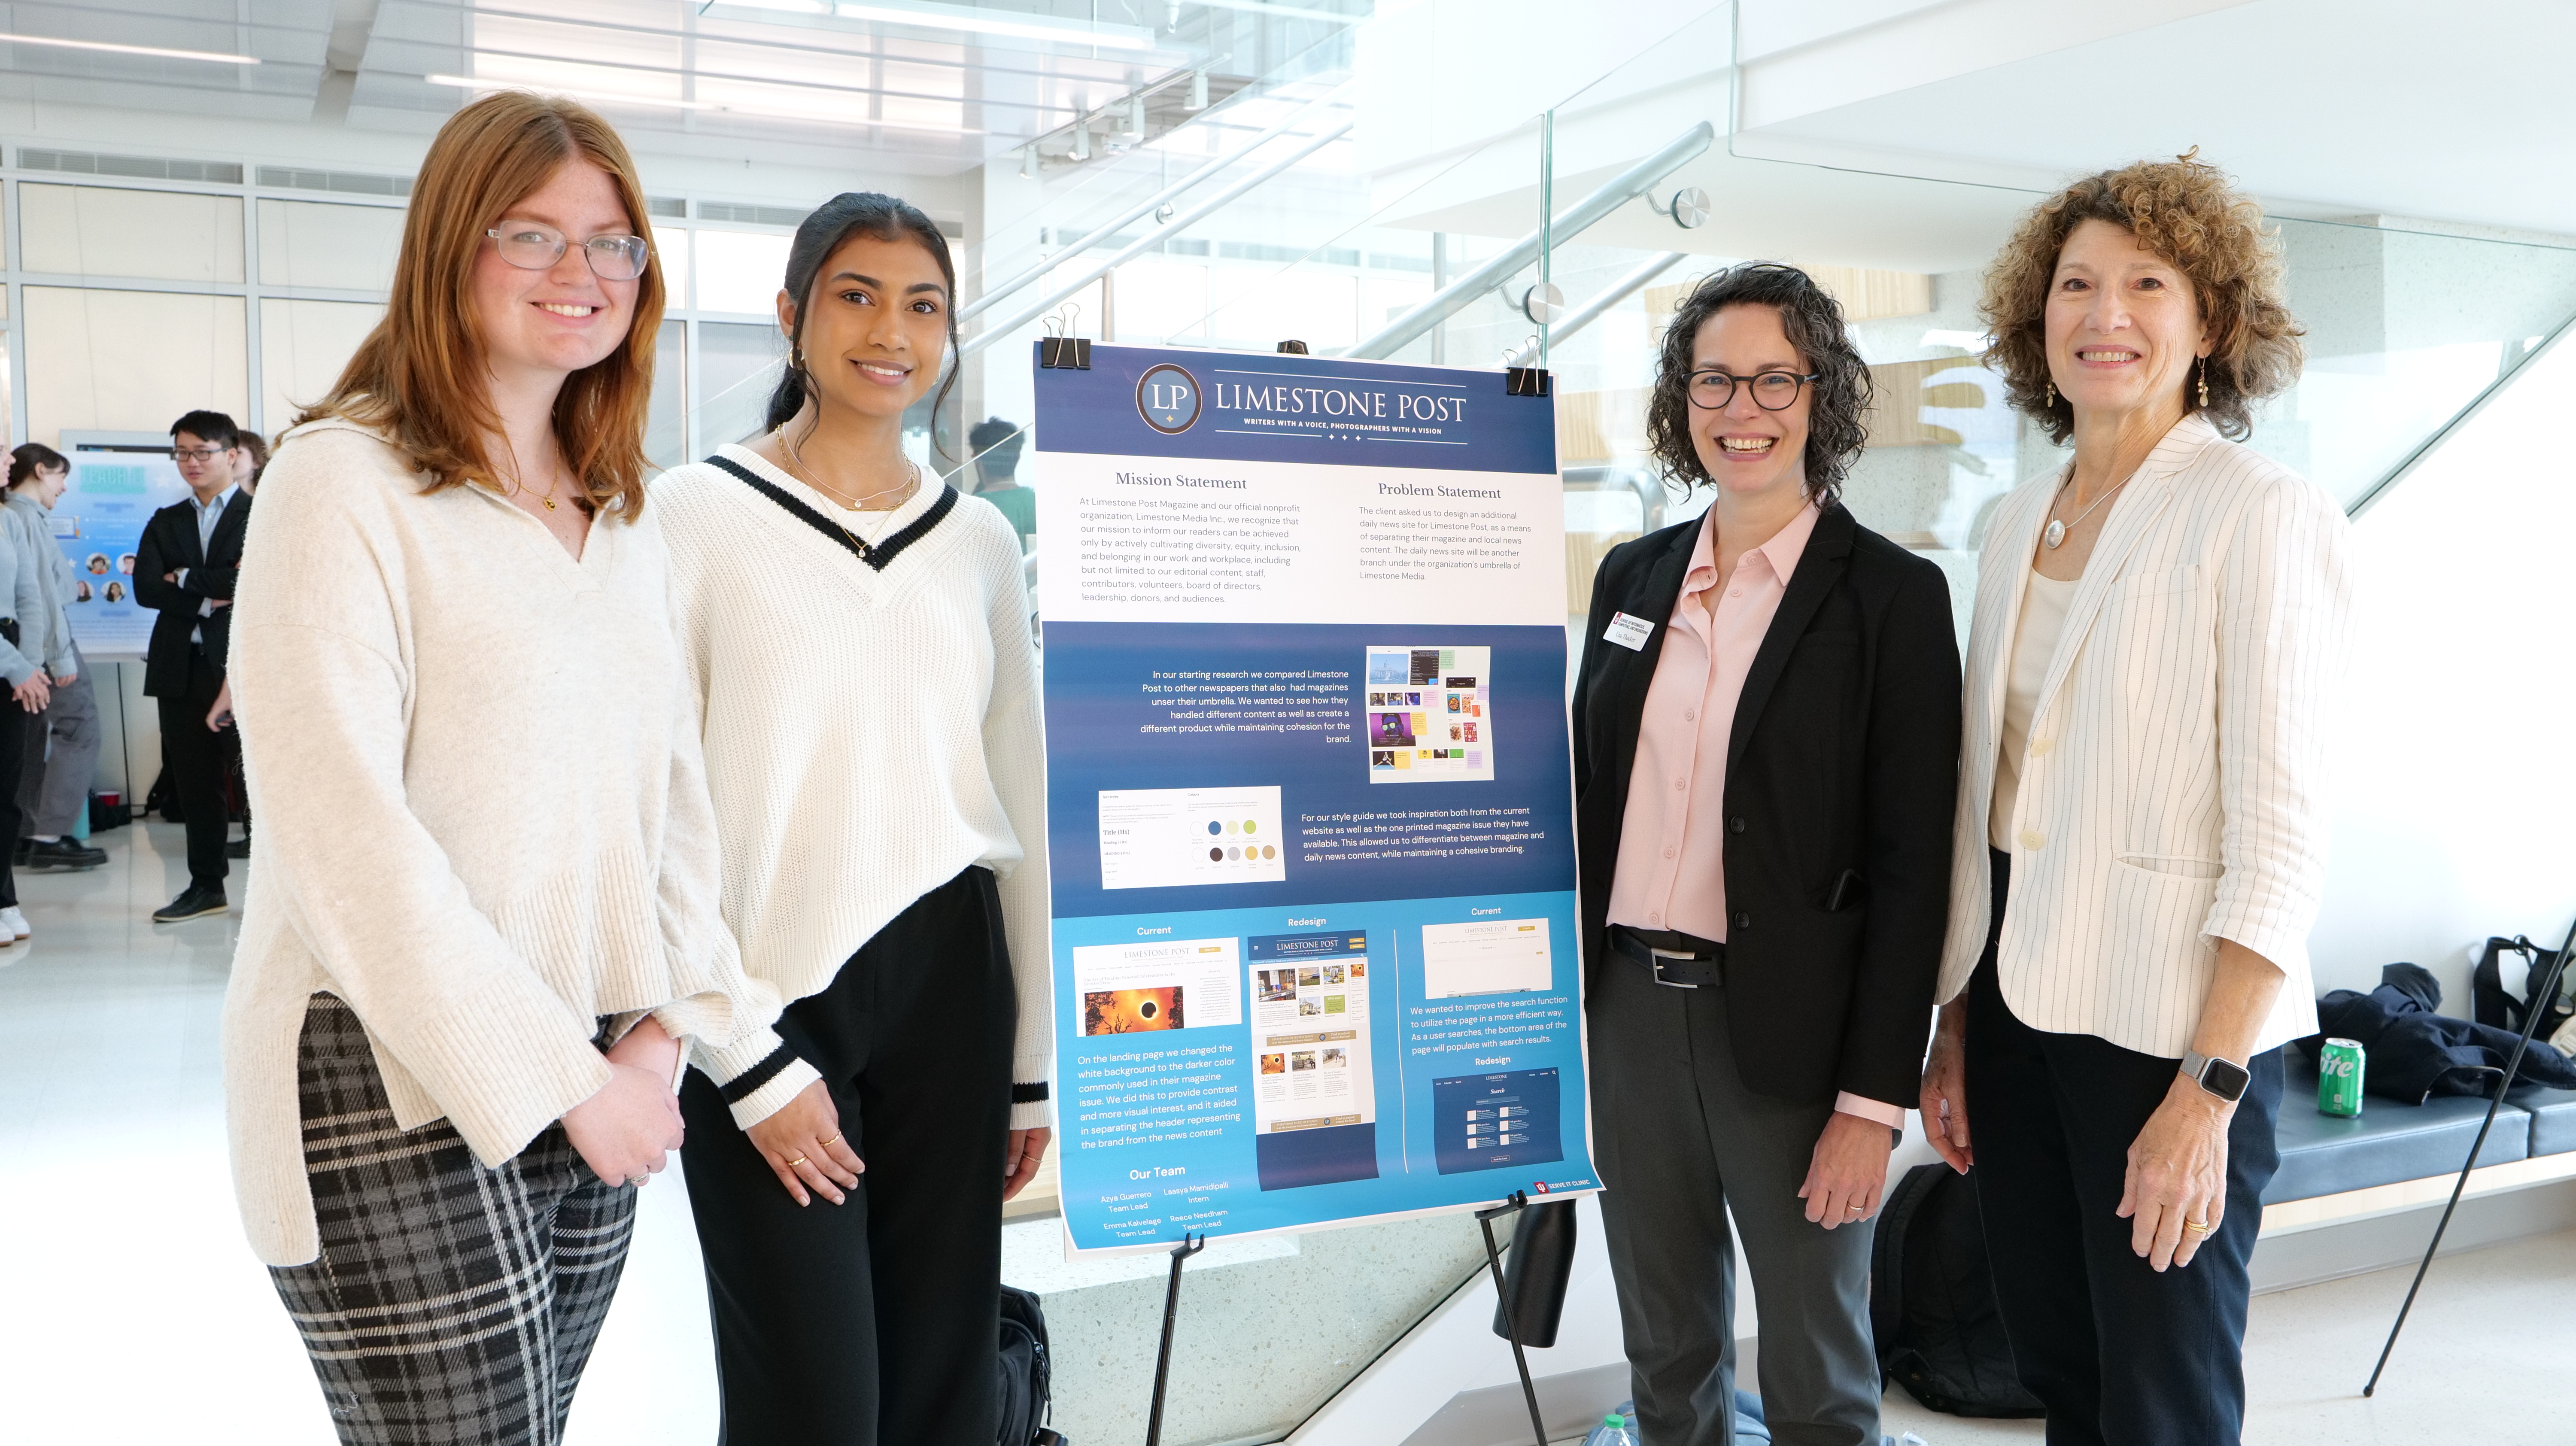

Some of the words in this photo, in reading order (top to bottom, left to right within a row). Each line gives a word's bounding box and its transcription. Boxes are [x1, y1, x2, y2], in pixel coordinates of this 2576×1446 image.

[1152, 384, 1188, 410] LP
[1215, 383, 1386, 417] LIMESTONE
[1397, 394, 1466, 422] POST
[1331, 422, 1390, 431] PHOTOGRAPHERS
[1115, 472, 1172, 486] Mission
[1176, 474, 1246, 489] Statement
[1378, 483, 1434, 496] Problem
[1437, 485, 1501, 498] Statement
[1091, 498, 1136, 507] Limestone
[1139, 499, 1157, 507] Post
[1160, 500, 1198, 510] Magazine
[1234, 502, 1261, 510] official
[1263, 504, 1300, 513] nonprofit
[1375, 507, 1396, 515] client
[1398, 508, 1421, 516] asked
[1443, 509, 1468, 519] design
[1481, 511, 1517, 519] additional
[1080, 513, 1133, 521] organization,
[1136, 512, 1180, 521] Limestone
[1182, 514, 1207, 522] Media
[1210, 515, 1225, 523] Inc.,
[1242, 516, 1280, 526] recognize
[1153, 670, 1160, 678] In
[1179, 670, 1211, 680] starting
[1212, 670, 1248, 678] research
[1264, 670, 1306, 680] compared
[1307, 670, 1349, 678] Limestone
[1326, 735, 1351, 743] brand.
[1301, 814, 1315, 822] For
[1332, 812, 1351, 822] style
[1352, 811, 1374, 822] guide
[1389, 810, 1406, 818] took
[1409, 809, 1448, 820] inspiration
[1450, 808, 1468, 817] both
[1471, 907, 1501, 915] Current
[1288, 917, 1326, 927] Redesign
[1137, 926, 1171, 935] Current
[1276, 941, 1318, 950] LIMESTONE
[1320, 939, 1338, 948] POST
[1124, 949, 1168, 958] LIMESTONE
[1425, 1004, 1453, 1014] wanted
[1465, 1002, 1495, 1012] improve
[1497, 1000, 1510, 1008] the
[1511, 997, 1536, 1007] search
[1537, 996, 1567, 1005] function
[1421, 1018, 1443, 1027] utilize
[1459, 1017, 1478, 1026] page
[1515, 1010, 1545, 1019] efficient
[1078, 1056, 1091, 1064] On
[1093, 1054, 1107, 1063] the
[1109, 1052, 1140, 1062] landing
[1142, 1051, 1164, 1061] page
[1180, 1045, 1216, 1056] changed
[1218, 1044, 1232, 1052] the
[1475, 1056, 1510, 1066] Redesign
[1078, 1069, 1102, 1078] white
[1104, 1063, 1155, 1076] background
[1169, 1062, 1183, 1070] the
[1185, 1060, 1212, 1069] darker
[1214, 1057, 1235, 1066] color
[1129, 1169, 1151, 1180] Our
[1153, 1167, 1185, 1177] Team
[1189, 1181, 1228, 1192] Mamidipalli
[1119, 1192, 1151, 1200] Guerrero
[1130, 1201, 1148, 1210] Lead
[1193, 1210, 1228, 1219] Needham
[1127, 1218, 1161, 1227] Kalvelage
[1203, 1219, 1221, 1228] Lead
